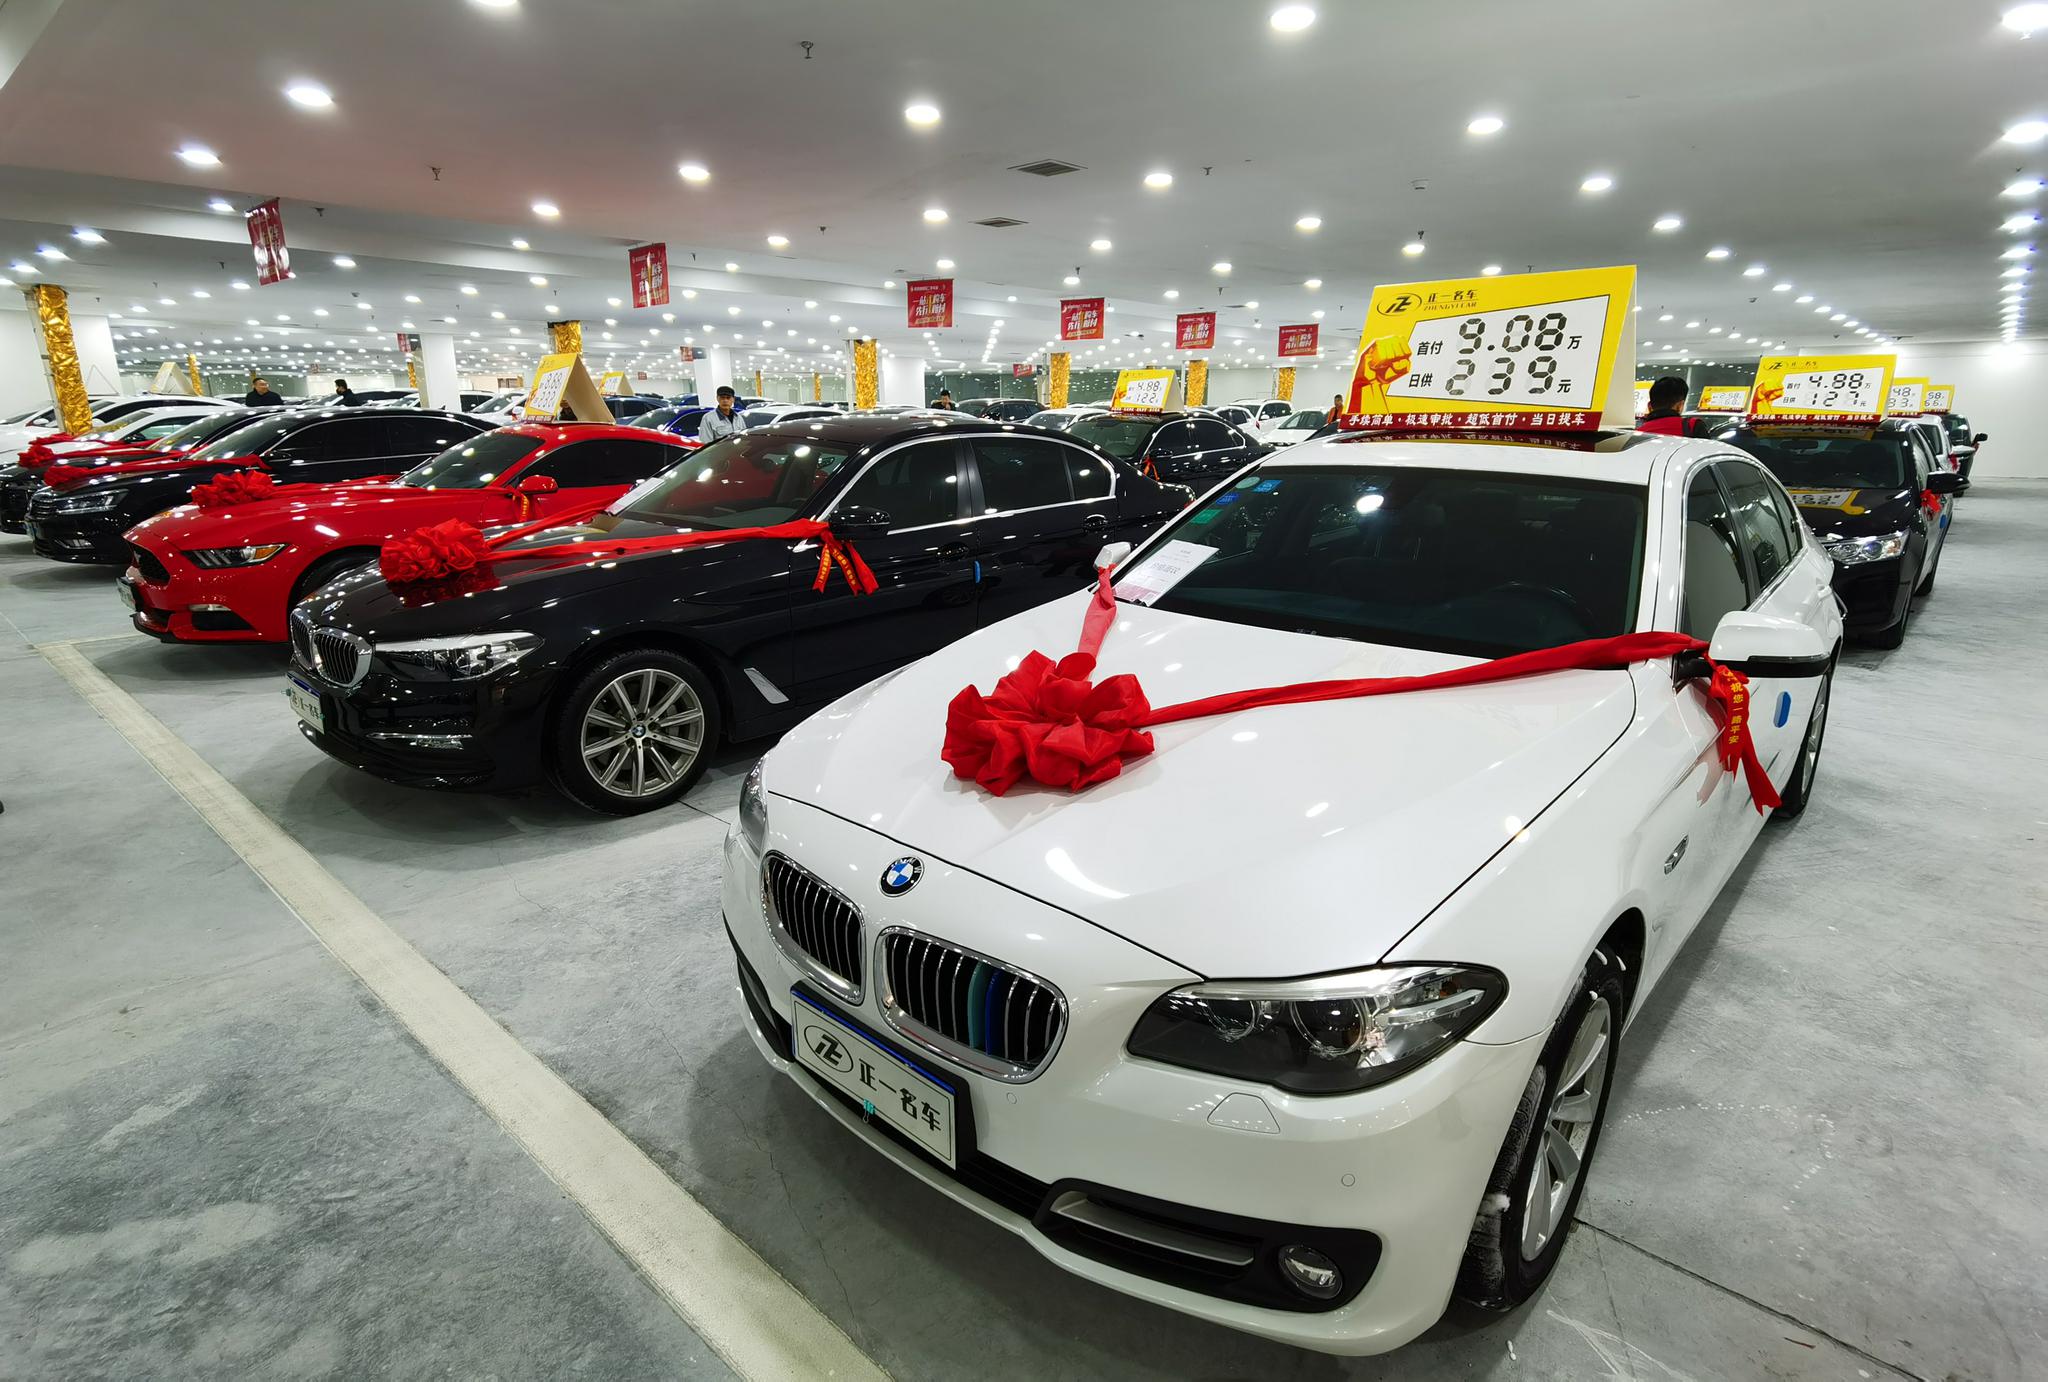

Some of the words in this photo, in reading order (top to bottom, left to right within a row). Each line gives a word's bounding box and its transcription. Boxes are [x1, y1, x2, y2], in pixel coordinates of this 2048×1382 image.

[1428, 289, 1478, 302] 正一名车
[1417, 340, 1443, 356] 首付
[1458, 312, 1568, 354] 9.08
[1568, 336, 1582, 350] 万
[1408, 373, 1432, 388] 日供
[1445, 355, 1557, 395] 239
[1557, 379, 1571, 393] 元
[1809, 373, 1864, 389] 4.88
[1138, 381, 1160, 391] 4.88
[1137, 393, 1157, 403] 122
[1811, 391, 1859, 407] 127
[859, 1057, 942, 1132] 正一名车
